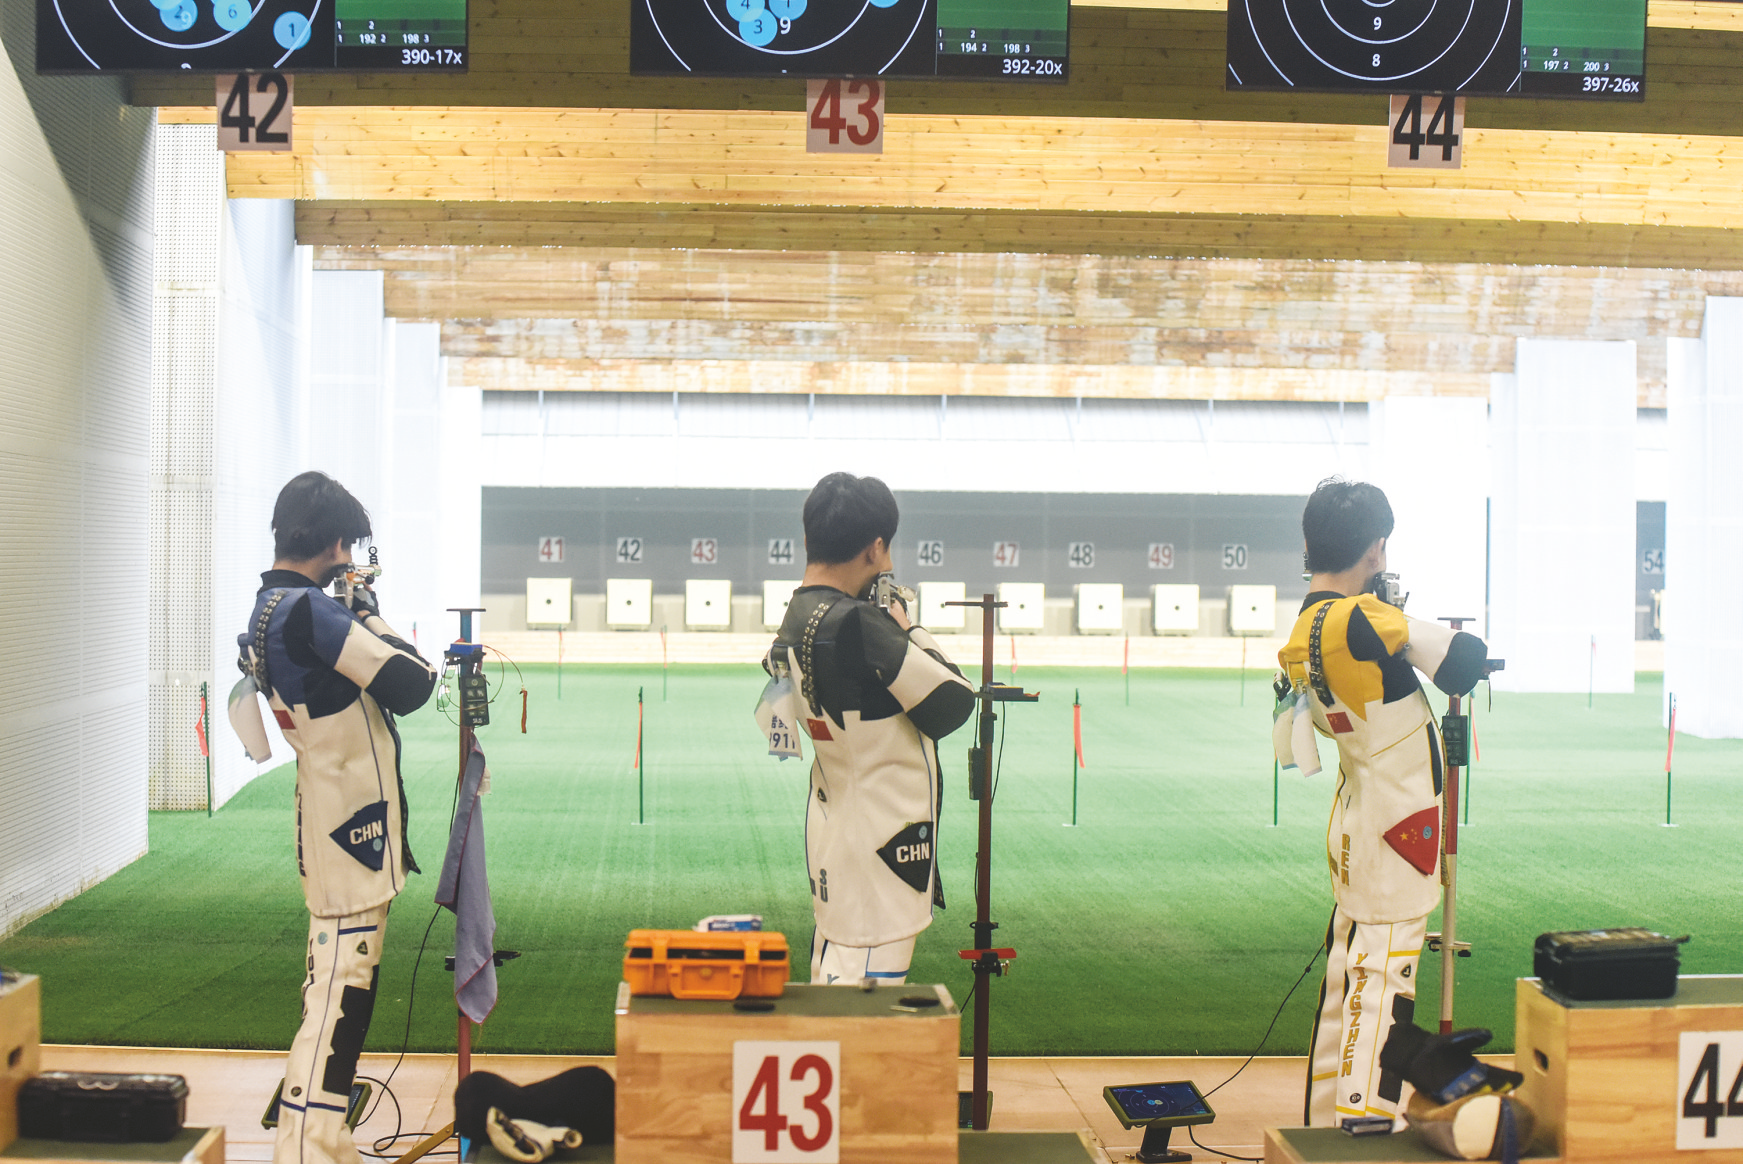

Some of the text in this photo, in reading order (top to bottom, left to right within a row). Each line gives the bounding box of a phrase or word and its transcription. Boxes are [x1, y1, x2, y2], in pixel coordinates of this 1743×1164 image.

[228, 4, 237, 18] 6
[289, 23, 295, 37] 1
[368, 20, 375, 30] 2
[753, 19, 763, 34] 3
[780, 16, 791, 35] 9
[970, 29, 976, 39] 2
[1373, 16, 1382, 30] 9
[380, 34, 387, 43] 2
[960, 42, 978, 53] 194
[981, 43, 987, 52] 2
[1003, 43, 1021, 54] 198
[401, 49, 463, 65] 390-17x
[1372, 53, 1381, 67] 8
[1552, 47, 1559, 57] 2
[1002, 58, 1064, 75] 392-20x
[1543, 60, 1560, 71] 197
[1563, 61, 1569, 70] 2
[1583, 61, 1601, 72] 200
[1581, 76, 1640, 93] 397-26x
[220, 72, 289, 144] 42
[810, 79, 881, 146] 43
[1393, 95, 1459, 162] 44
[541, 537, 564, 561] 41
[618, 538, 641, 562] 42
[692, 540, 716, 562] 43
[770, 540, 792, 563] 44
[919, 542, 942, 565] 46
[995, 543, 1018, 566] 47
[1071, 544, 1094, 566] 48
[1149, 544, 1173, 567] 49
[1223, 545, 1246, 568] 50
[1644, 551, 1665, 573] 54
[350, 819, 383, 845] CHN
[896, 842, 930, 863] CHN
[1341, 833, 1350, 887] REN
[1341, 953, 1368, 1077] YINGZHEN
[739, 1054, 833, 1152] 43
